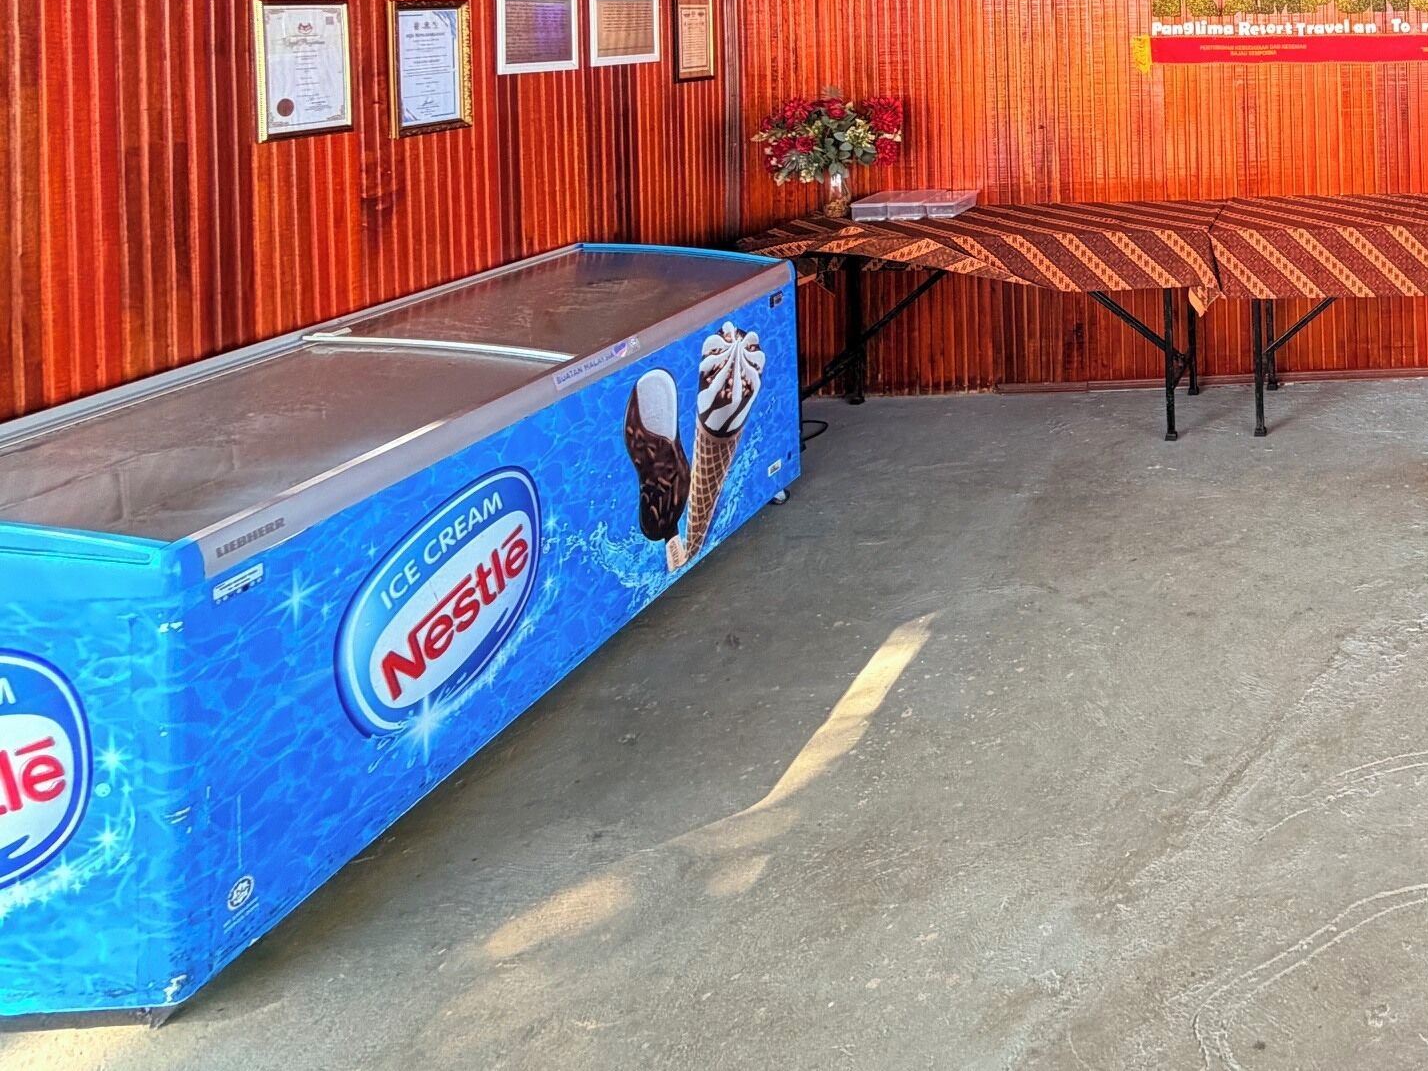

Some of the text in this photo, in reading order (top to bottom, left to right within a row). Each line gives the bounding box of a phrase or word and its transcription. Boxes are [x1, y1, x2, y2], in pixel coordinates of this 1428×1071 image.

[1152, 21, 1234, 35] Panglima
[1296, 20, 1349, 36] Travel
[216, 517, 285, 558] LIEBHERR
[379, 491, 503, 610] ICE CREAM
[380, 523, 529, 701] Nestlé
